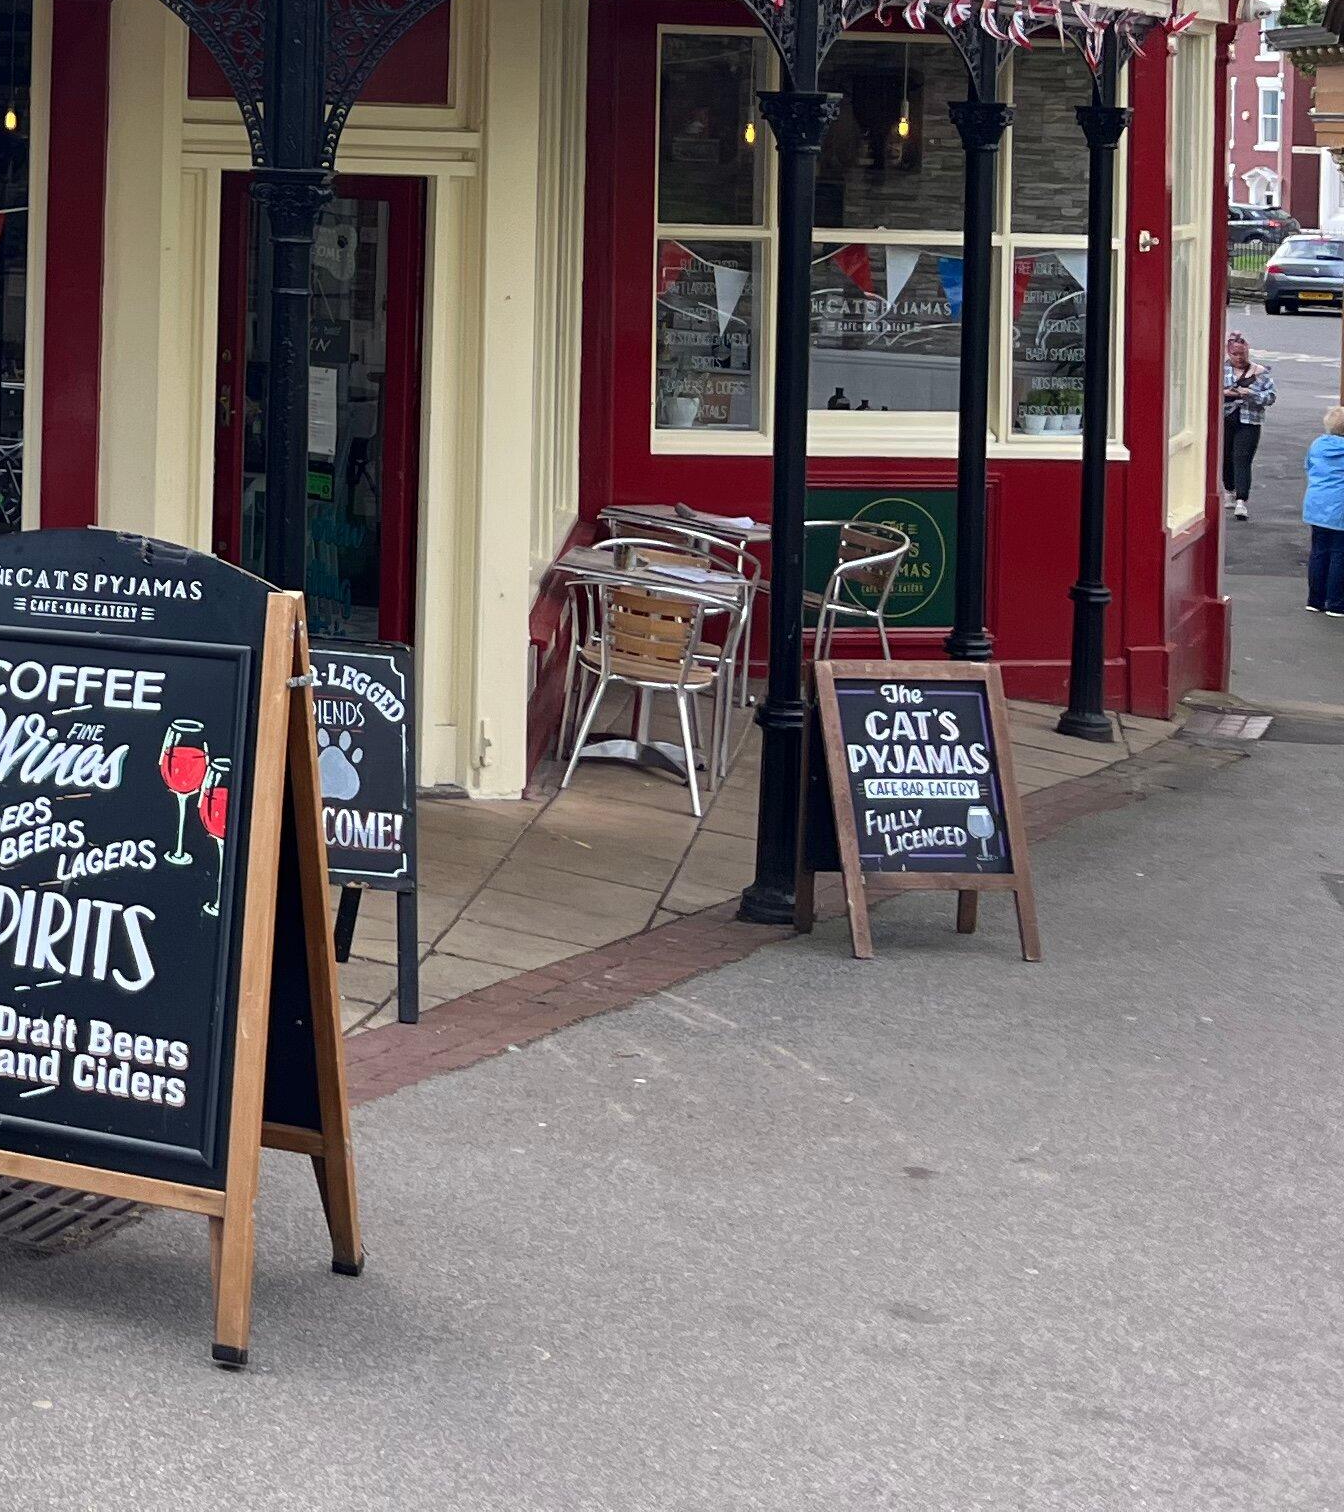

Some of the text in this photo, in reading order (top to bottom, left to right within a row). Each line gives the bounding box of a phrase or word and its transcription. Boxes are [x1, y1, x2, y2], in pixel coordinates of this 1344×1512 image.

[94, 574, 202, 601] PYJAMAS
[30, 599, 138, 620] CAFE BAR EATERY
[309, 662, 405, 723] R-LEGGED
[879, 684, 924, 705] The
[313, 698, 365, 727] IENDS
[865, 709, 960, 741] CAT'S
[67, 722, 106, 742] FINE
[846, 743, 991, 775] PYJAMAS
[868, 780, 977, 797] CAFE BAR EATERY
[322, 806, 403, 852] COME!
[864, 808, 923, 837] FULLY
[884, 825, 968, 856] LICENCED
[56, 839, 156, 882] LAGERS
[89, 1023, 189, 1072] Beers
[72, 1054, 187, 1106] Ciders
